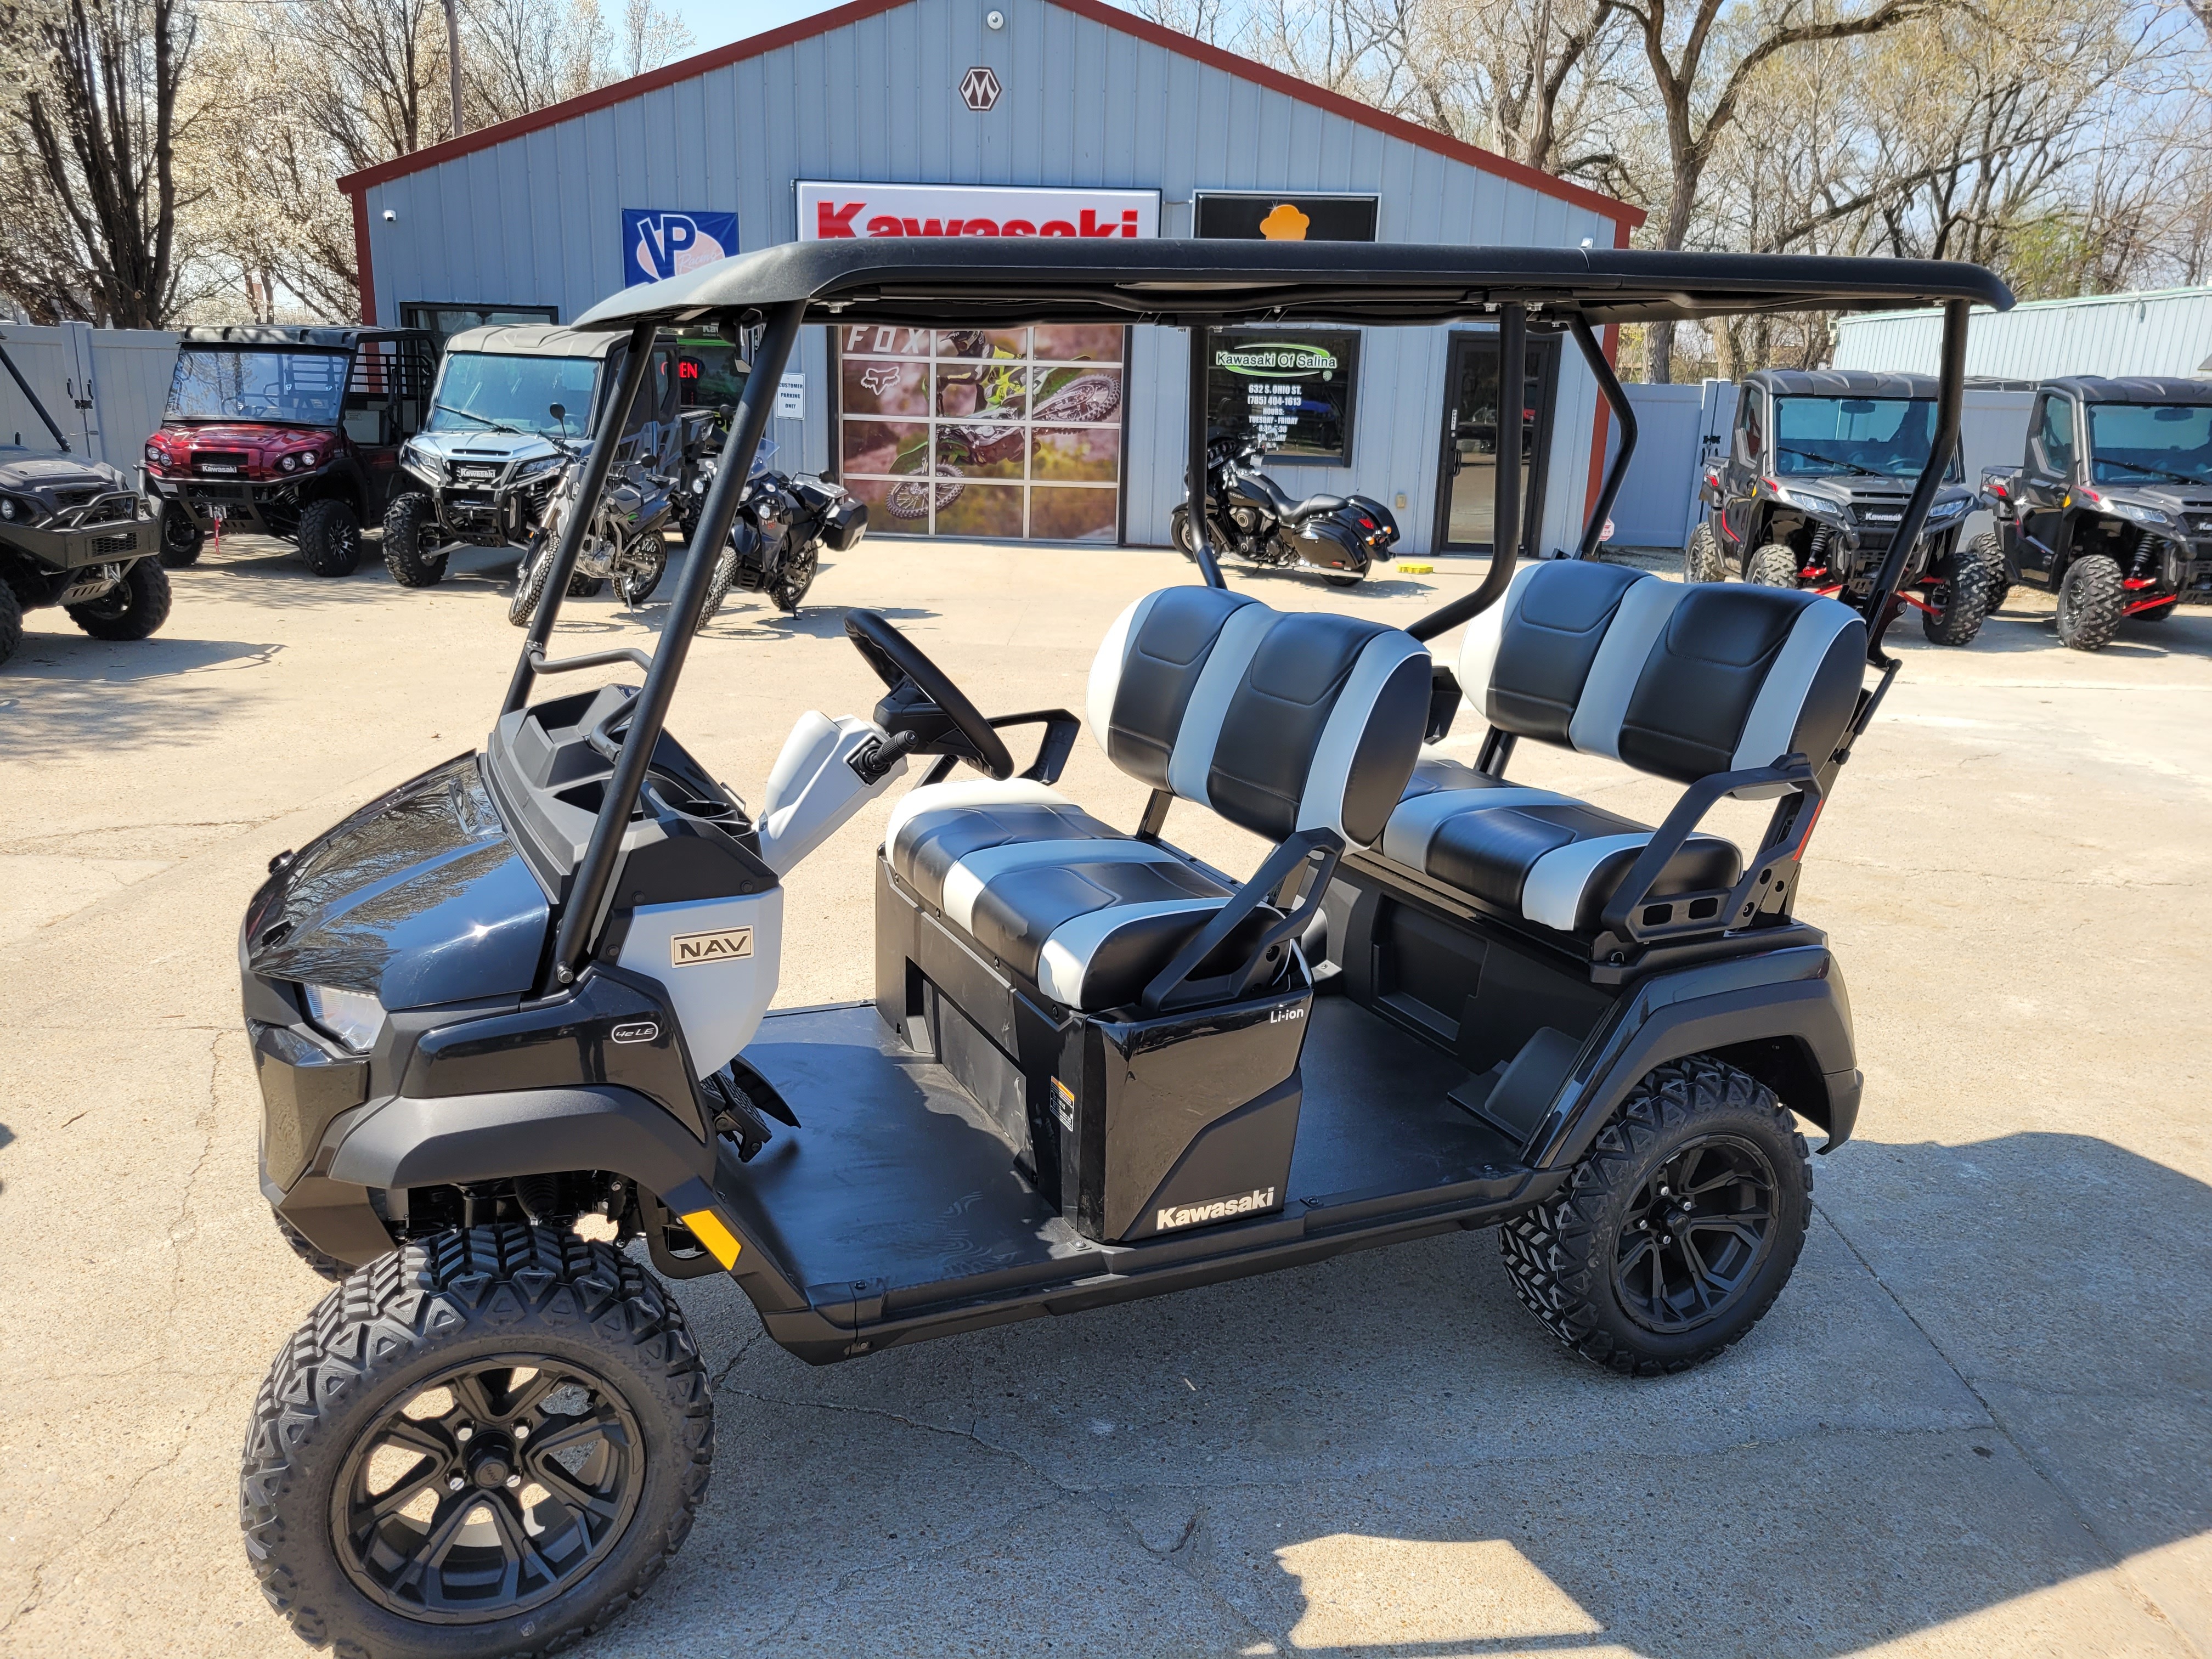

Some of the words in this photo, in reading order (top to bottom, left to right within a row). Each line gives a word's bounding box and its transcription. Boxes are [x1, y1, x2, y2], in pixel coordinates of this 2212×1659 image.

[637, 214, 697, 280] VP
[847, 326, 926, 354] FOX
[1217, 352, 1275, 366] Kawasaki
[1278, 354, 1295, 366] Of
[1297, 355, 1336, 368] Salina
[1248, 385, 1263, 394] 632
[1264, 385, 1272, 394] S.
[1272, 385, 1290, 394] OHIO
[1291, 386, 1302, 395] ST.
[1247, 395, 1267, 405] (785)
[1268, 396, 1301, 406] 404-1613
[1257, 433, 1287, 442] SADAY
[460, 469, 496, 478] Kawasaki
[1865, 512, 1903, 521] Kawasak
[679, 935, 748, 959] NAV
[1270, 1008, 1304, 1024] Li-ion
[635, 1028, 654, 1036] LE
[1157, 1187, 1274, 1230] Kawasaki
